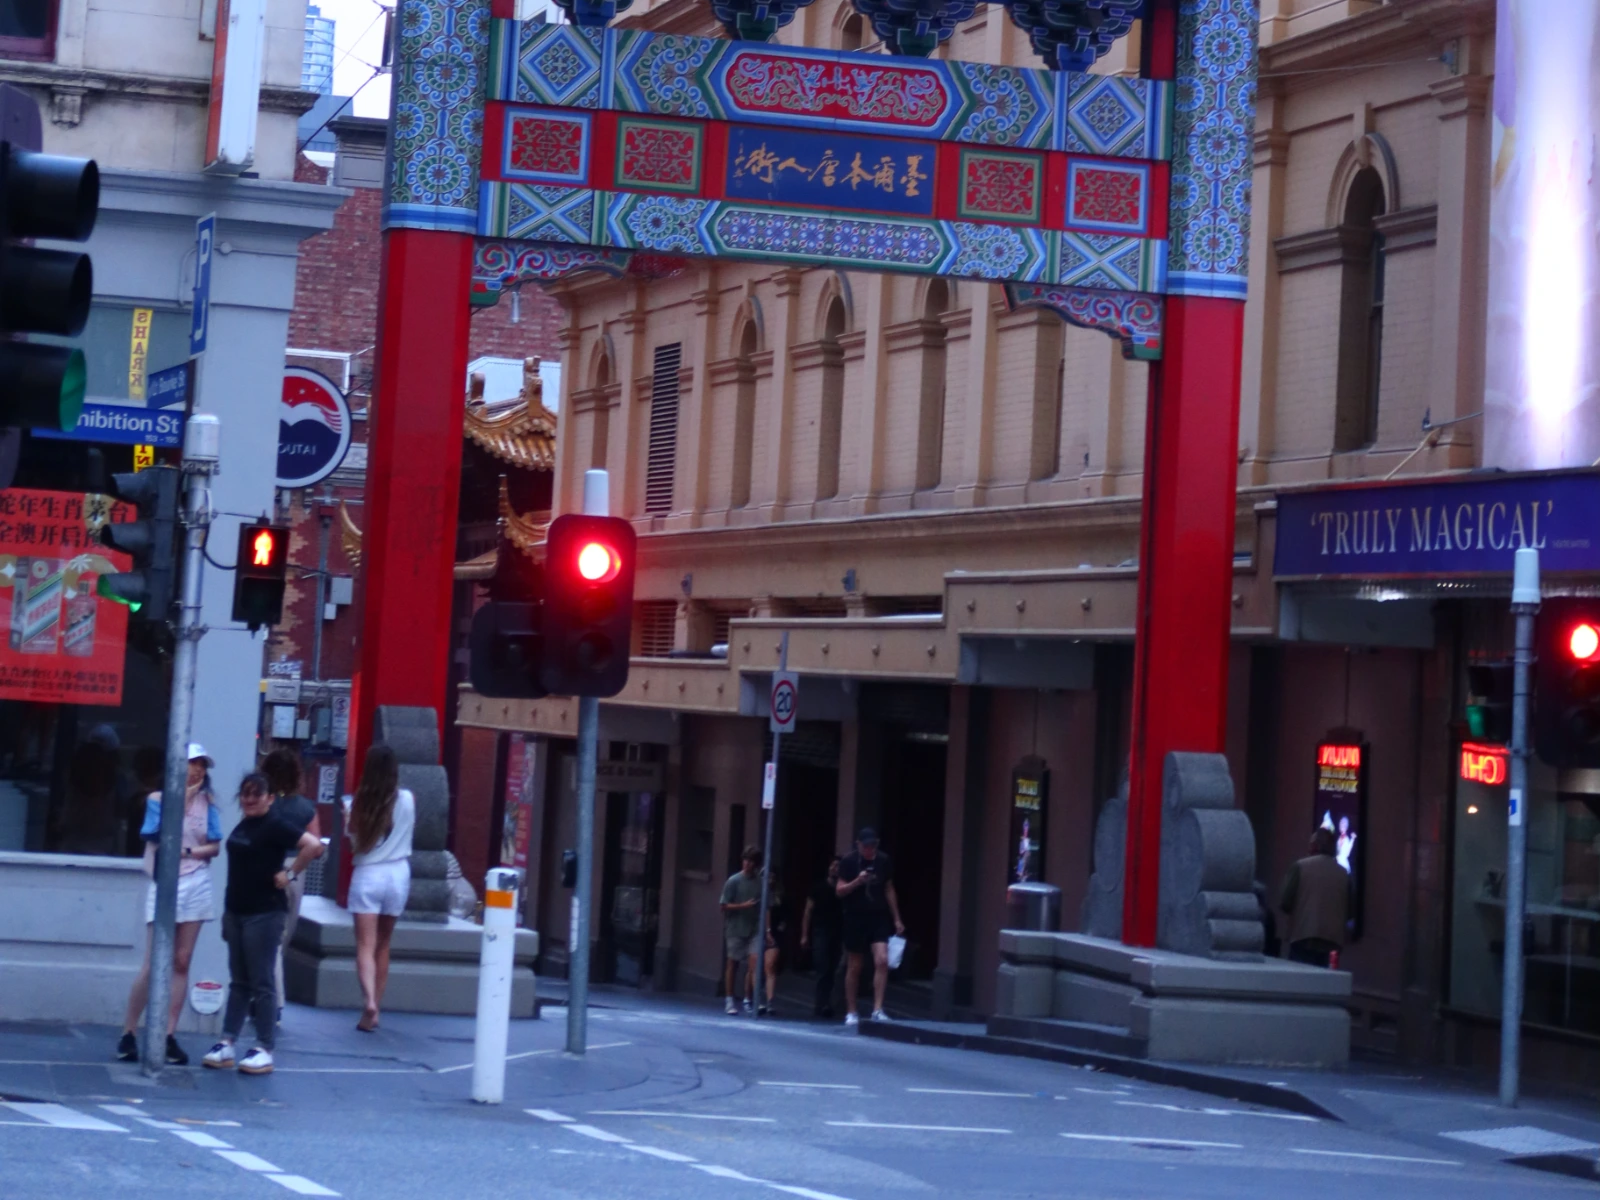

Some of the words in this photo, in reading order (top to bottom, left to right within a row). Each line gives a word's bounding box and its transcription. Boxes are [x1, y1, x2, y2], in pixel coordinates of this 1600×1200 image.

[77, 411, 152, 432] hibition
[156, 415, 179, 435] St
[278, 443, 317, 455] OUTAI
[776, 691, 792, 713] 20
